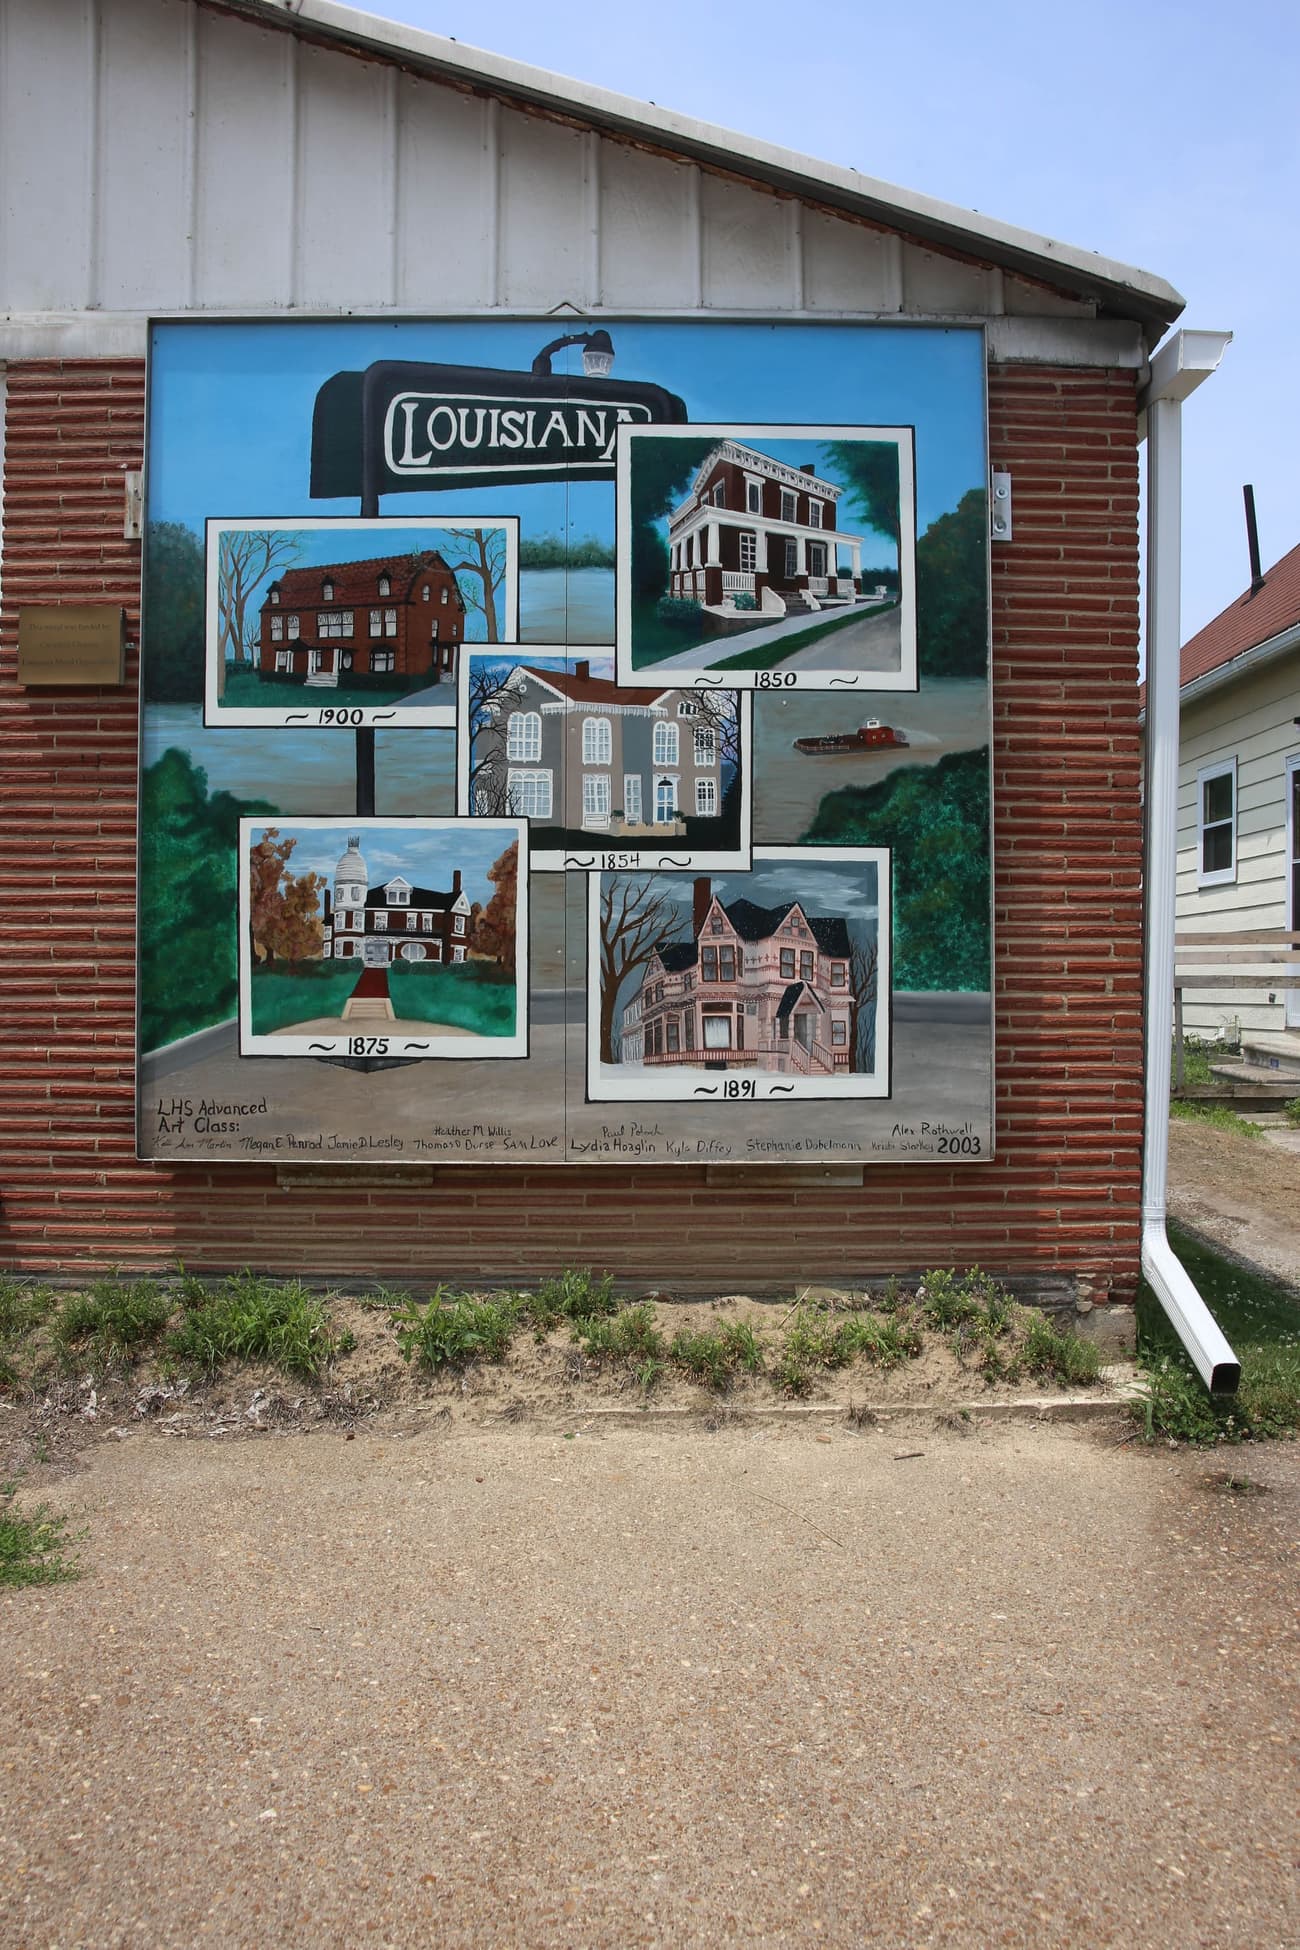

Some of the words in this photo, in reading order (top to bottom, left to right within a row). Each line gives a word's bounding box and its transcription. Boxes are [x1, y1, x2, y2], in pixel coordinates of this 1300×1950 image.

[754, 671, 797, 688] 1850
[319, 708, 363, 725] 1900
[601, 852, 640, 870] 1854
[348, 1036, 390, 1055] 1875
[723, 1079, 756, 1098] 1891
[157, 1099, 193, 1116] LHS
[198, 1097, 268, 1116] Advanced
[158, 1117, 184, 1133] Art
[194, 1117, 240, 1133] Class:
[571, 1137, 610, 1152] Lydia
[937, 1136, 982, 1155] 2003
